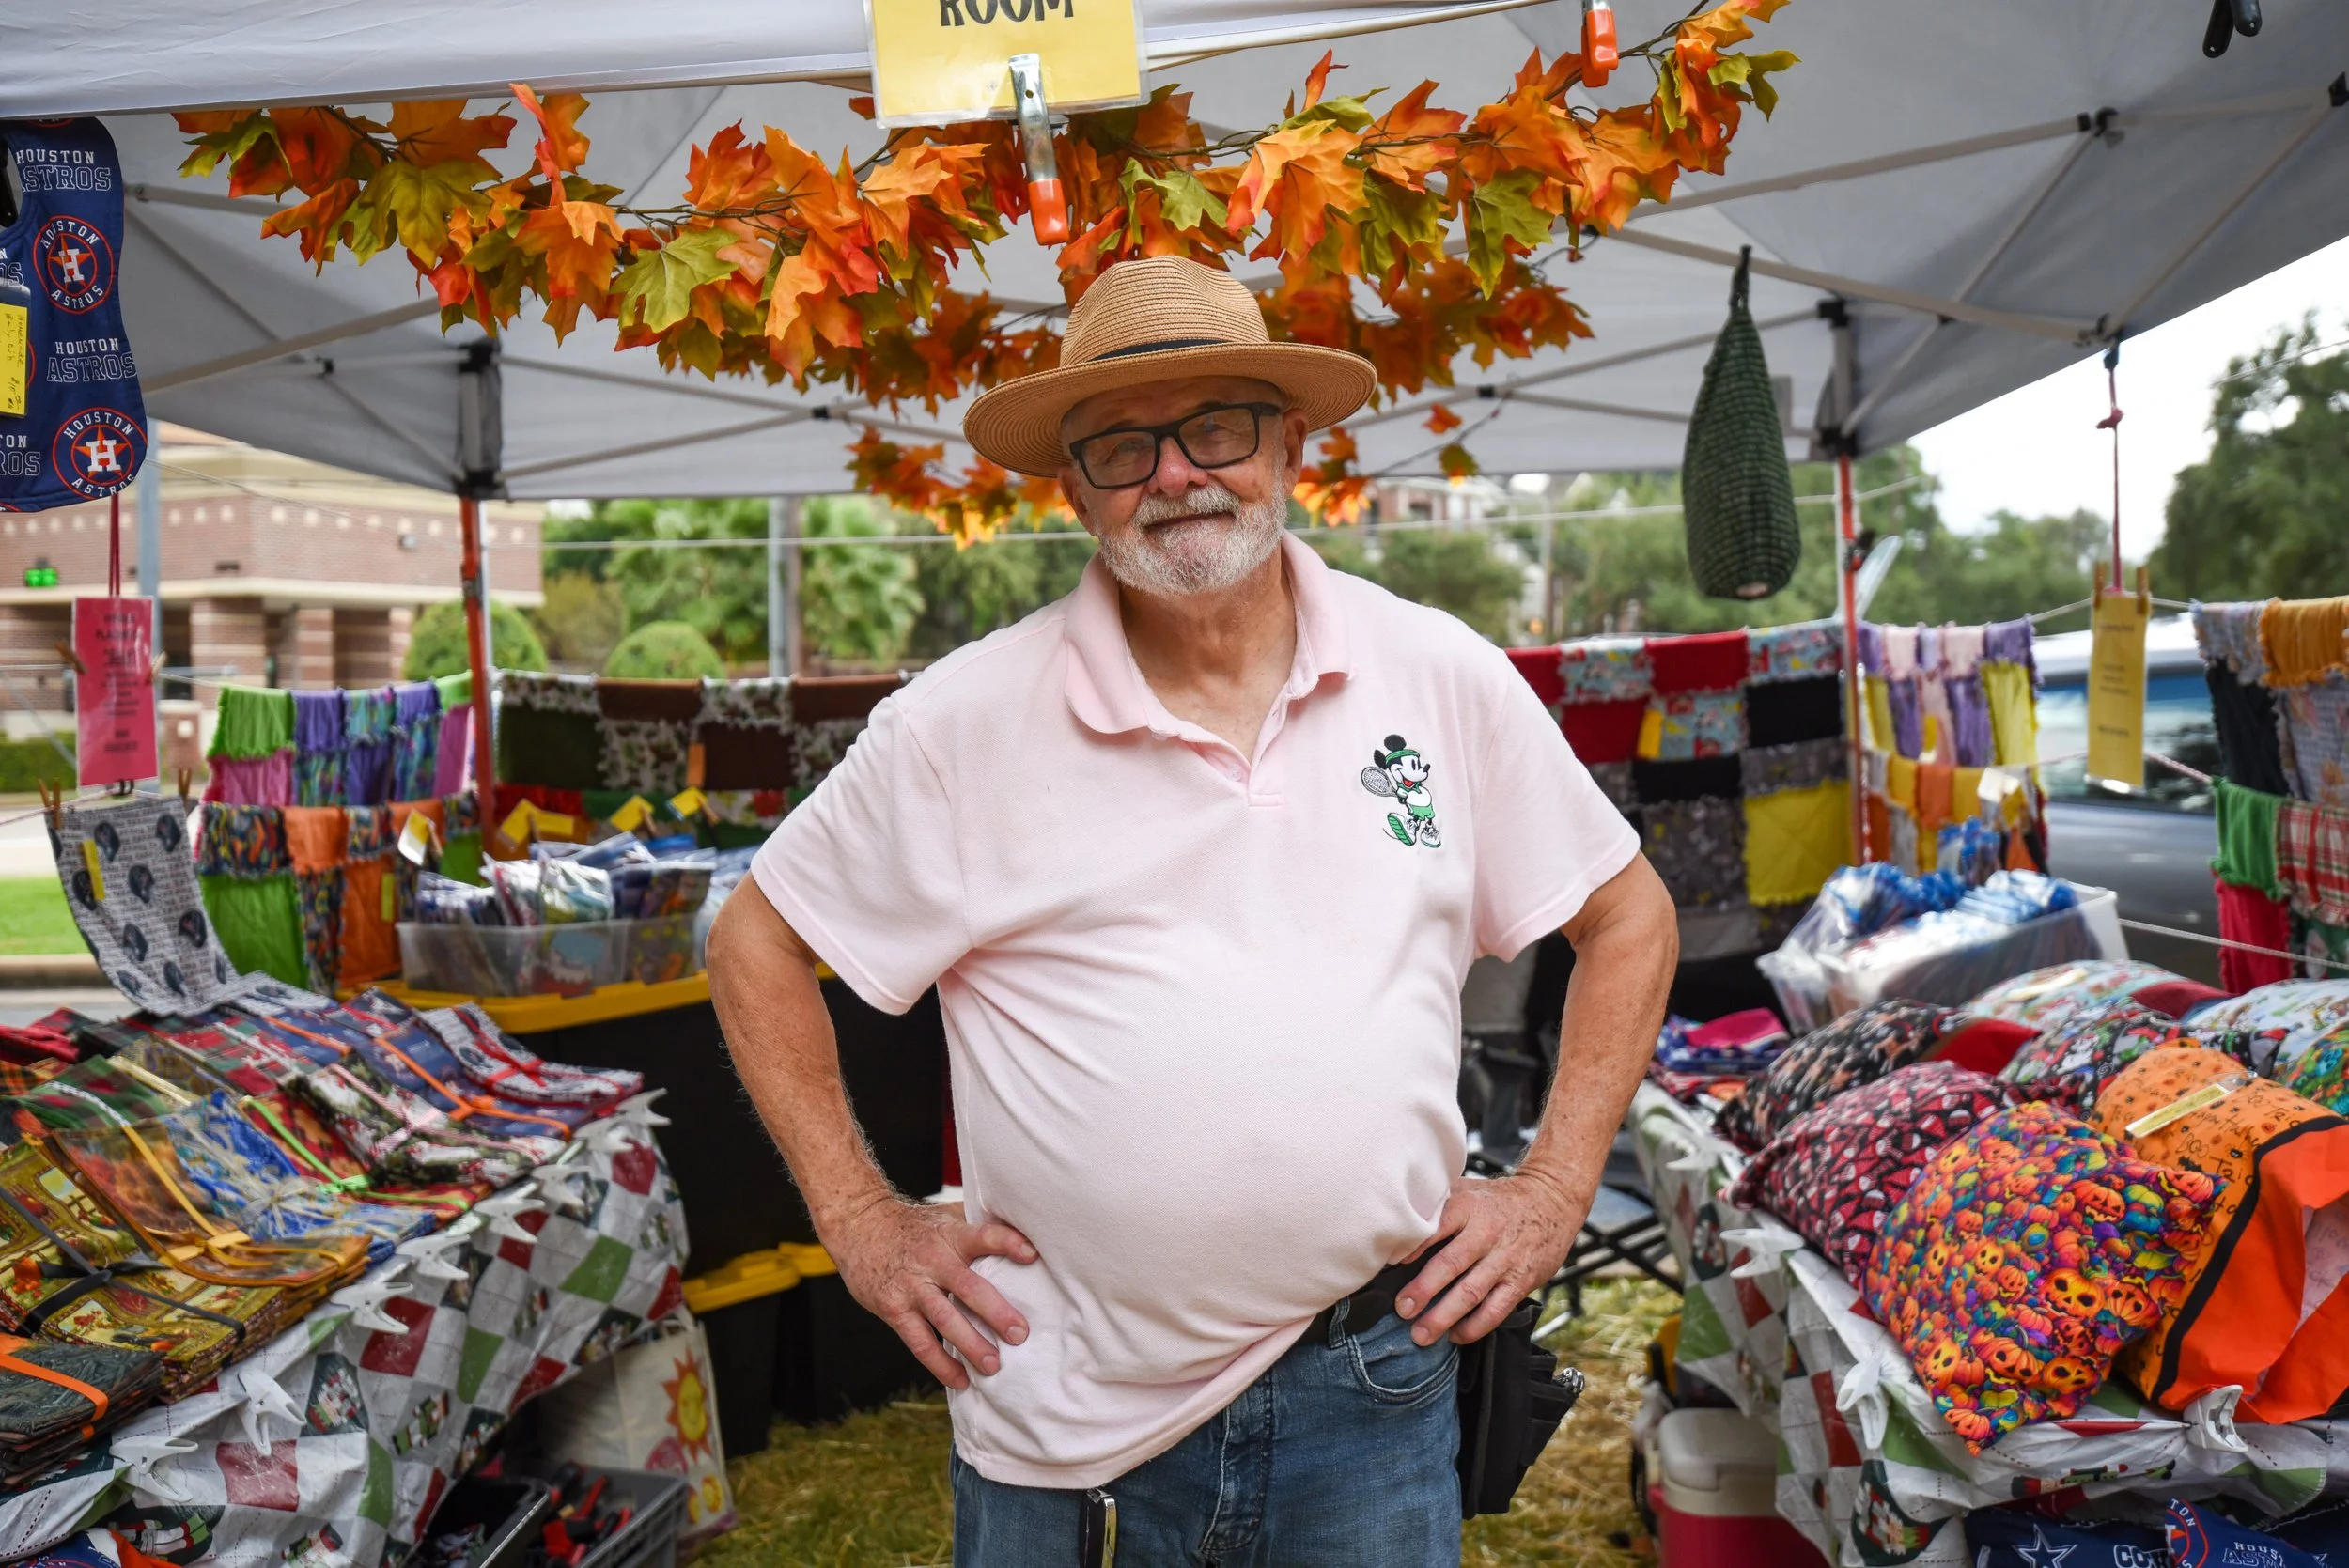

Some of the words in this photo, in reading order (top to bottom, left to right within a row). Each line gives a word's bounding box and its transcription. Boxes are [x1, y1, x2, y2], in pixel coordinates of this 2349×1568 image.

[16, 148, 94, 164] HOUSTON
[23, 164, 112, 193] STROS
[51, 285, 103, 309] ASTROS
[54, 337, 119, 355] HOUSTON
[46, 351, 138, 383] ASTROS
[63, 411, 134, 440] HOUSTON
